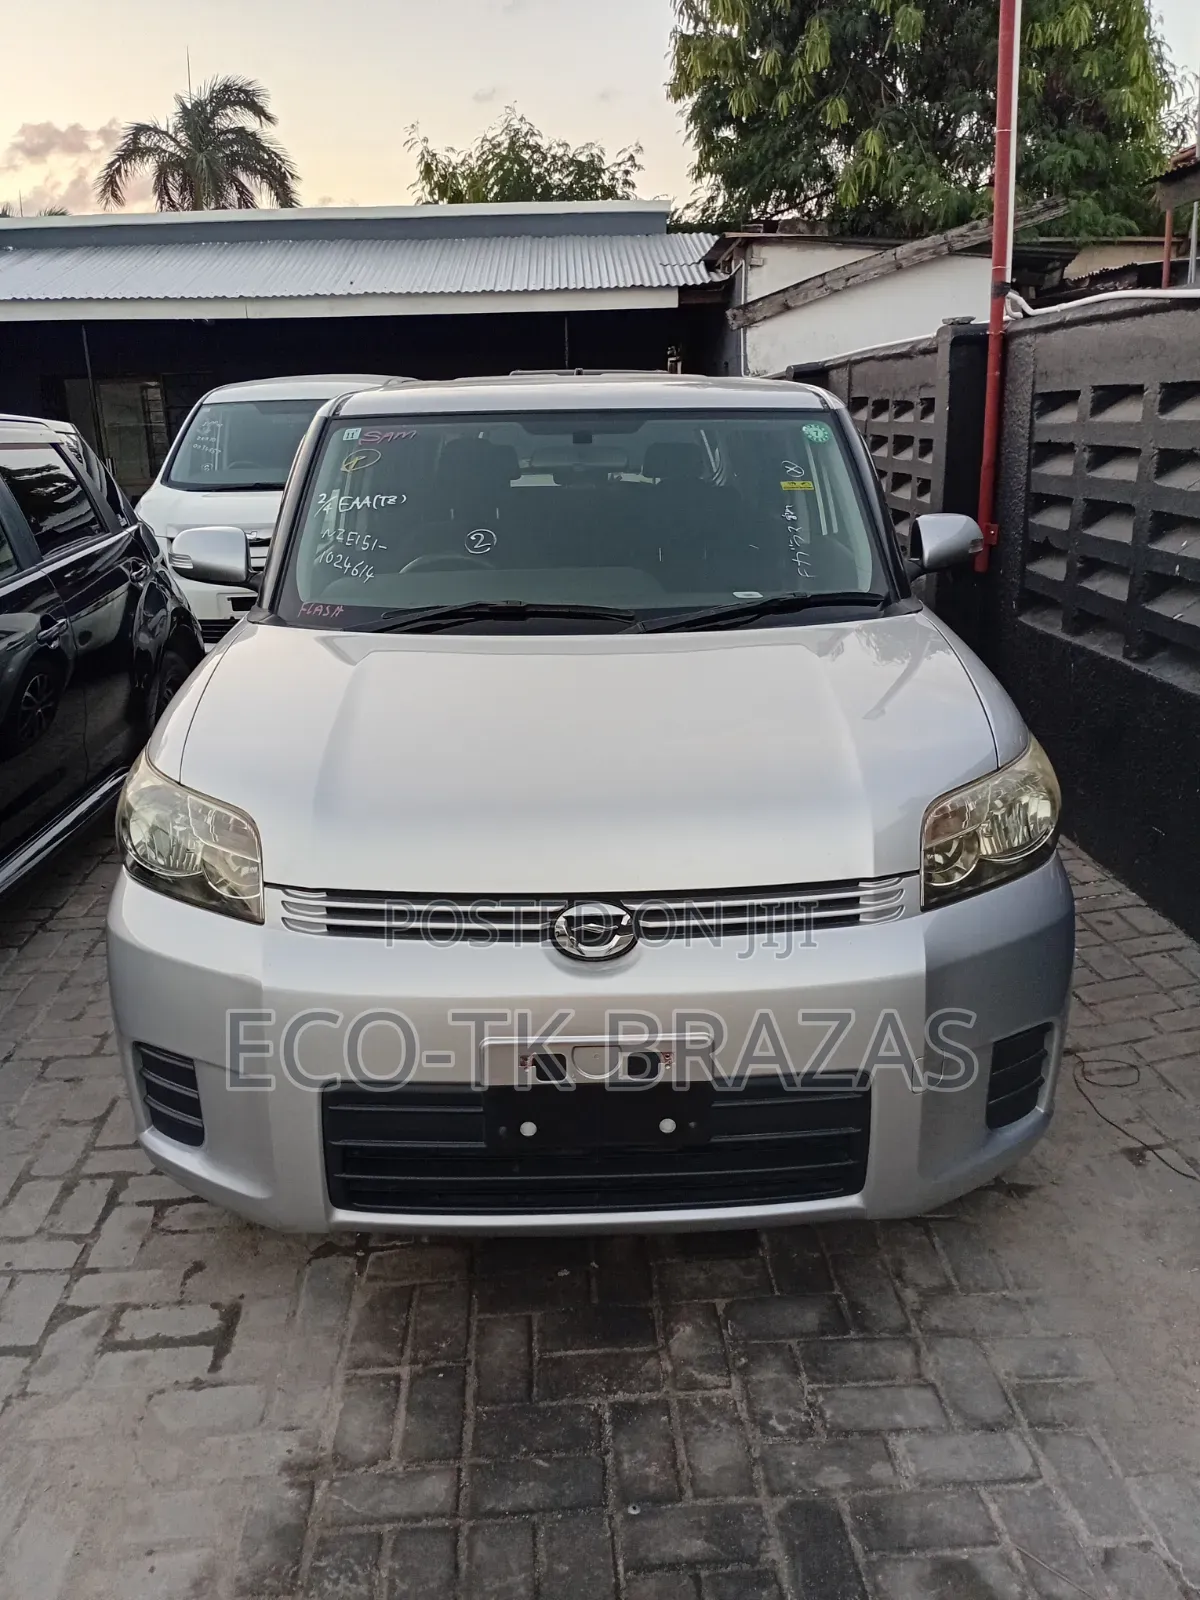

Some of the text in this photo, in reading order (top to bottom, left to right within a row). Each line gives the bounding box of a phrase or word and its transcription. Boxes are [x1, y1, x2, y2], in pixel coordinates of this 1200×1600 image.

[358, 430, 417, 446] SAM
[319, 550, 375, 583] 1024614
[297, 602, 344, 618] FLASH
